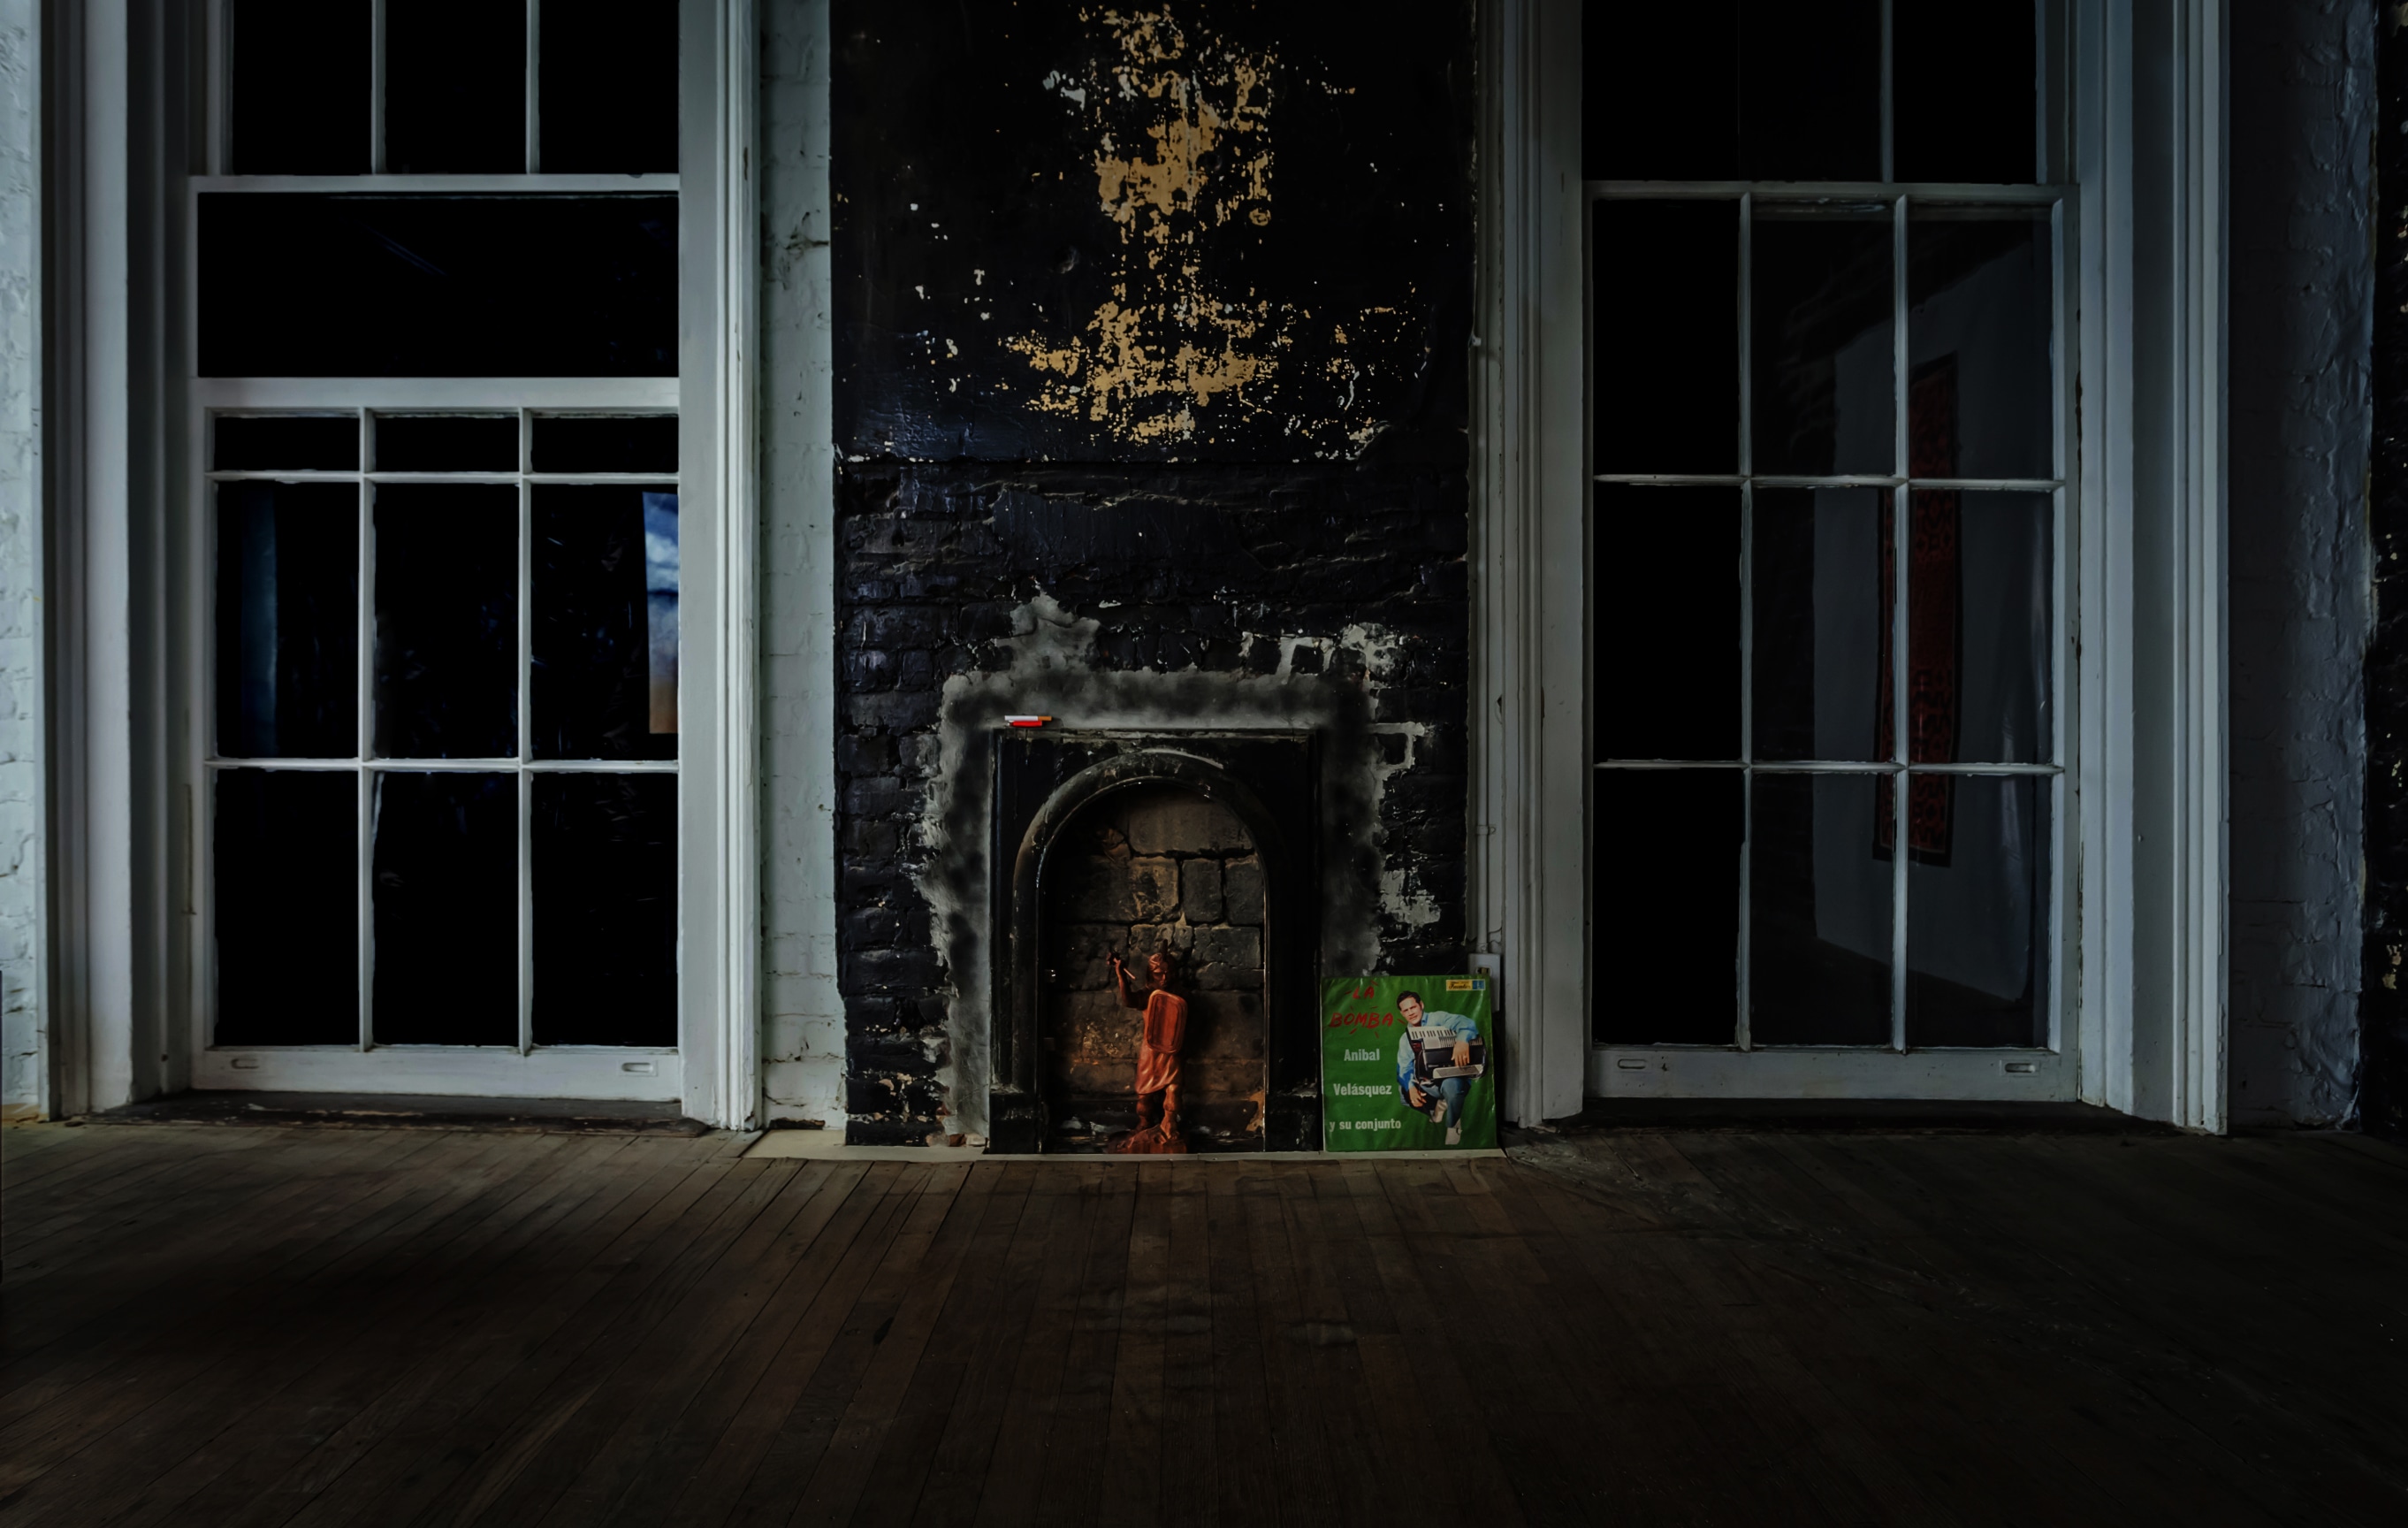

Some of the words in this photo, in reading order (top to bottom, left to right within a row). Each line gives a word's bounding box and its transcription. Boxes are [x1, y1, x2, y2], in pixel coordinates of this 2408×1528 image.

[1353, 986, 1375, 999] LA
[1330, 1012, 1393, 1028] BOMBA
[1344, 1048, 1380, 1061] Anibal
[1333, 1083, 1392, 1097] Velásquez
[1329, 1121, 1336, 1133] y
[1339, 1119, 1352, 1130] su
[1355, 1118, 1401, 1131] conjunto
